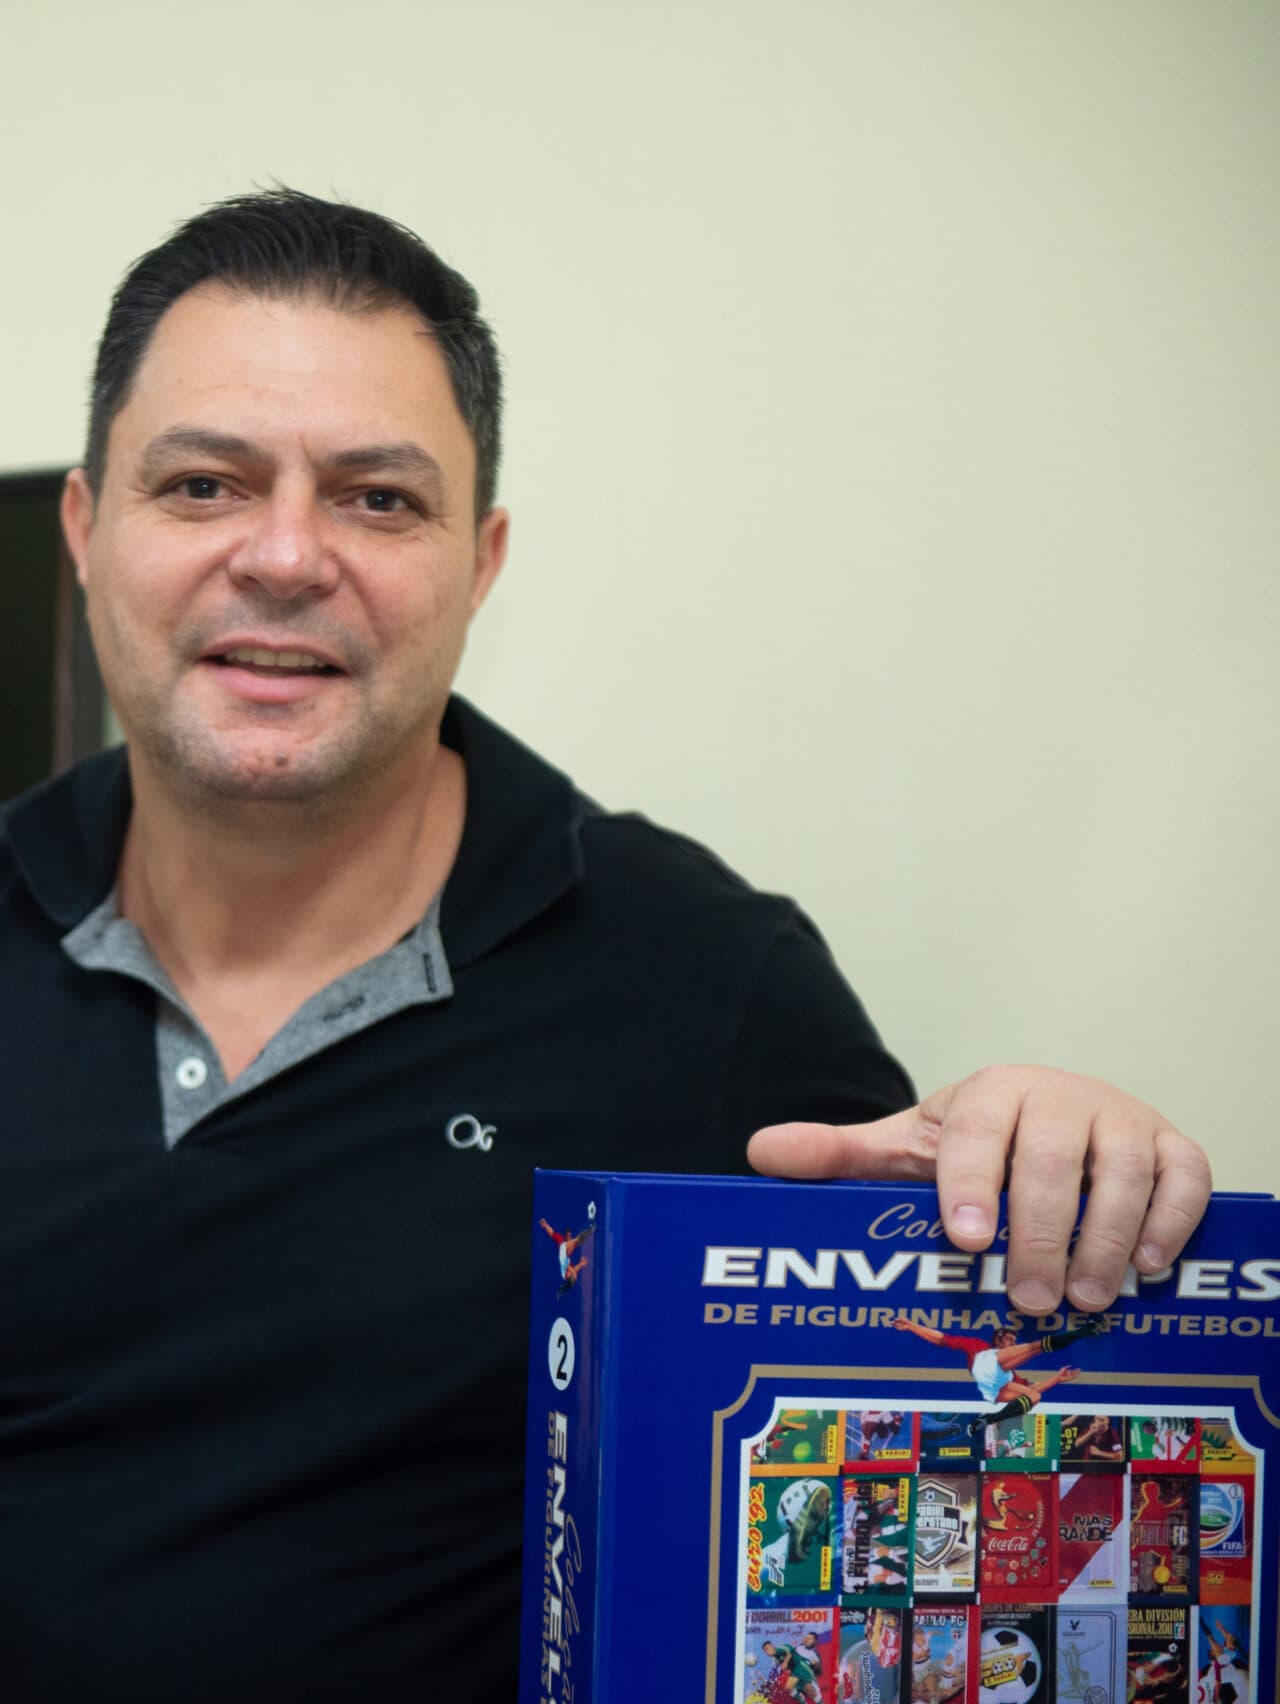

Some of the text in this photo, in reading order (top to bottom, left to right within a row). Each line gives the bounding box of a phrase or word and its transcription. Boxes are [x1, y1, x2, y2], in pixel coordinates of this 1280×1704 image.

[701, 1245, 1280, 1301] ENVELPES
[704, 1303, 1280, 1338] DE FIGURINHAS DE FUTEBOL
[556, 1334, 568, 1382] 2
[1060, 1525, 1113, 1541] RANDE
[548, 1410, 568, 1704] ENVEL
[793, 1610, 827, 1623] 2001
